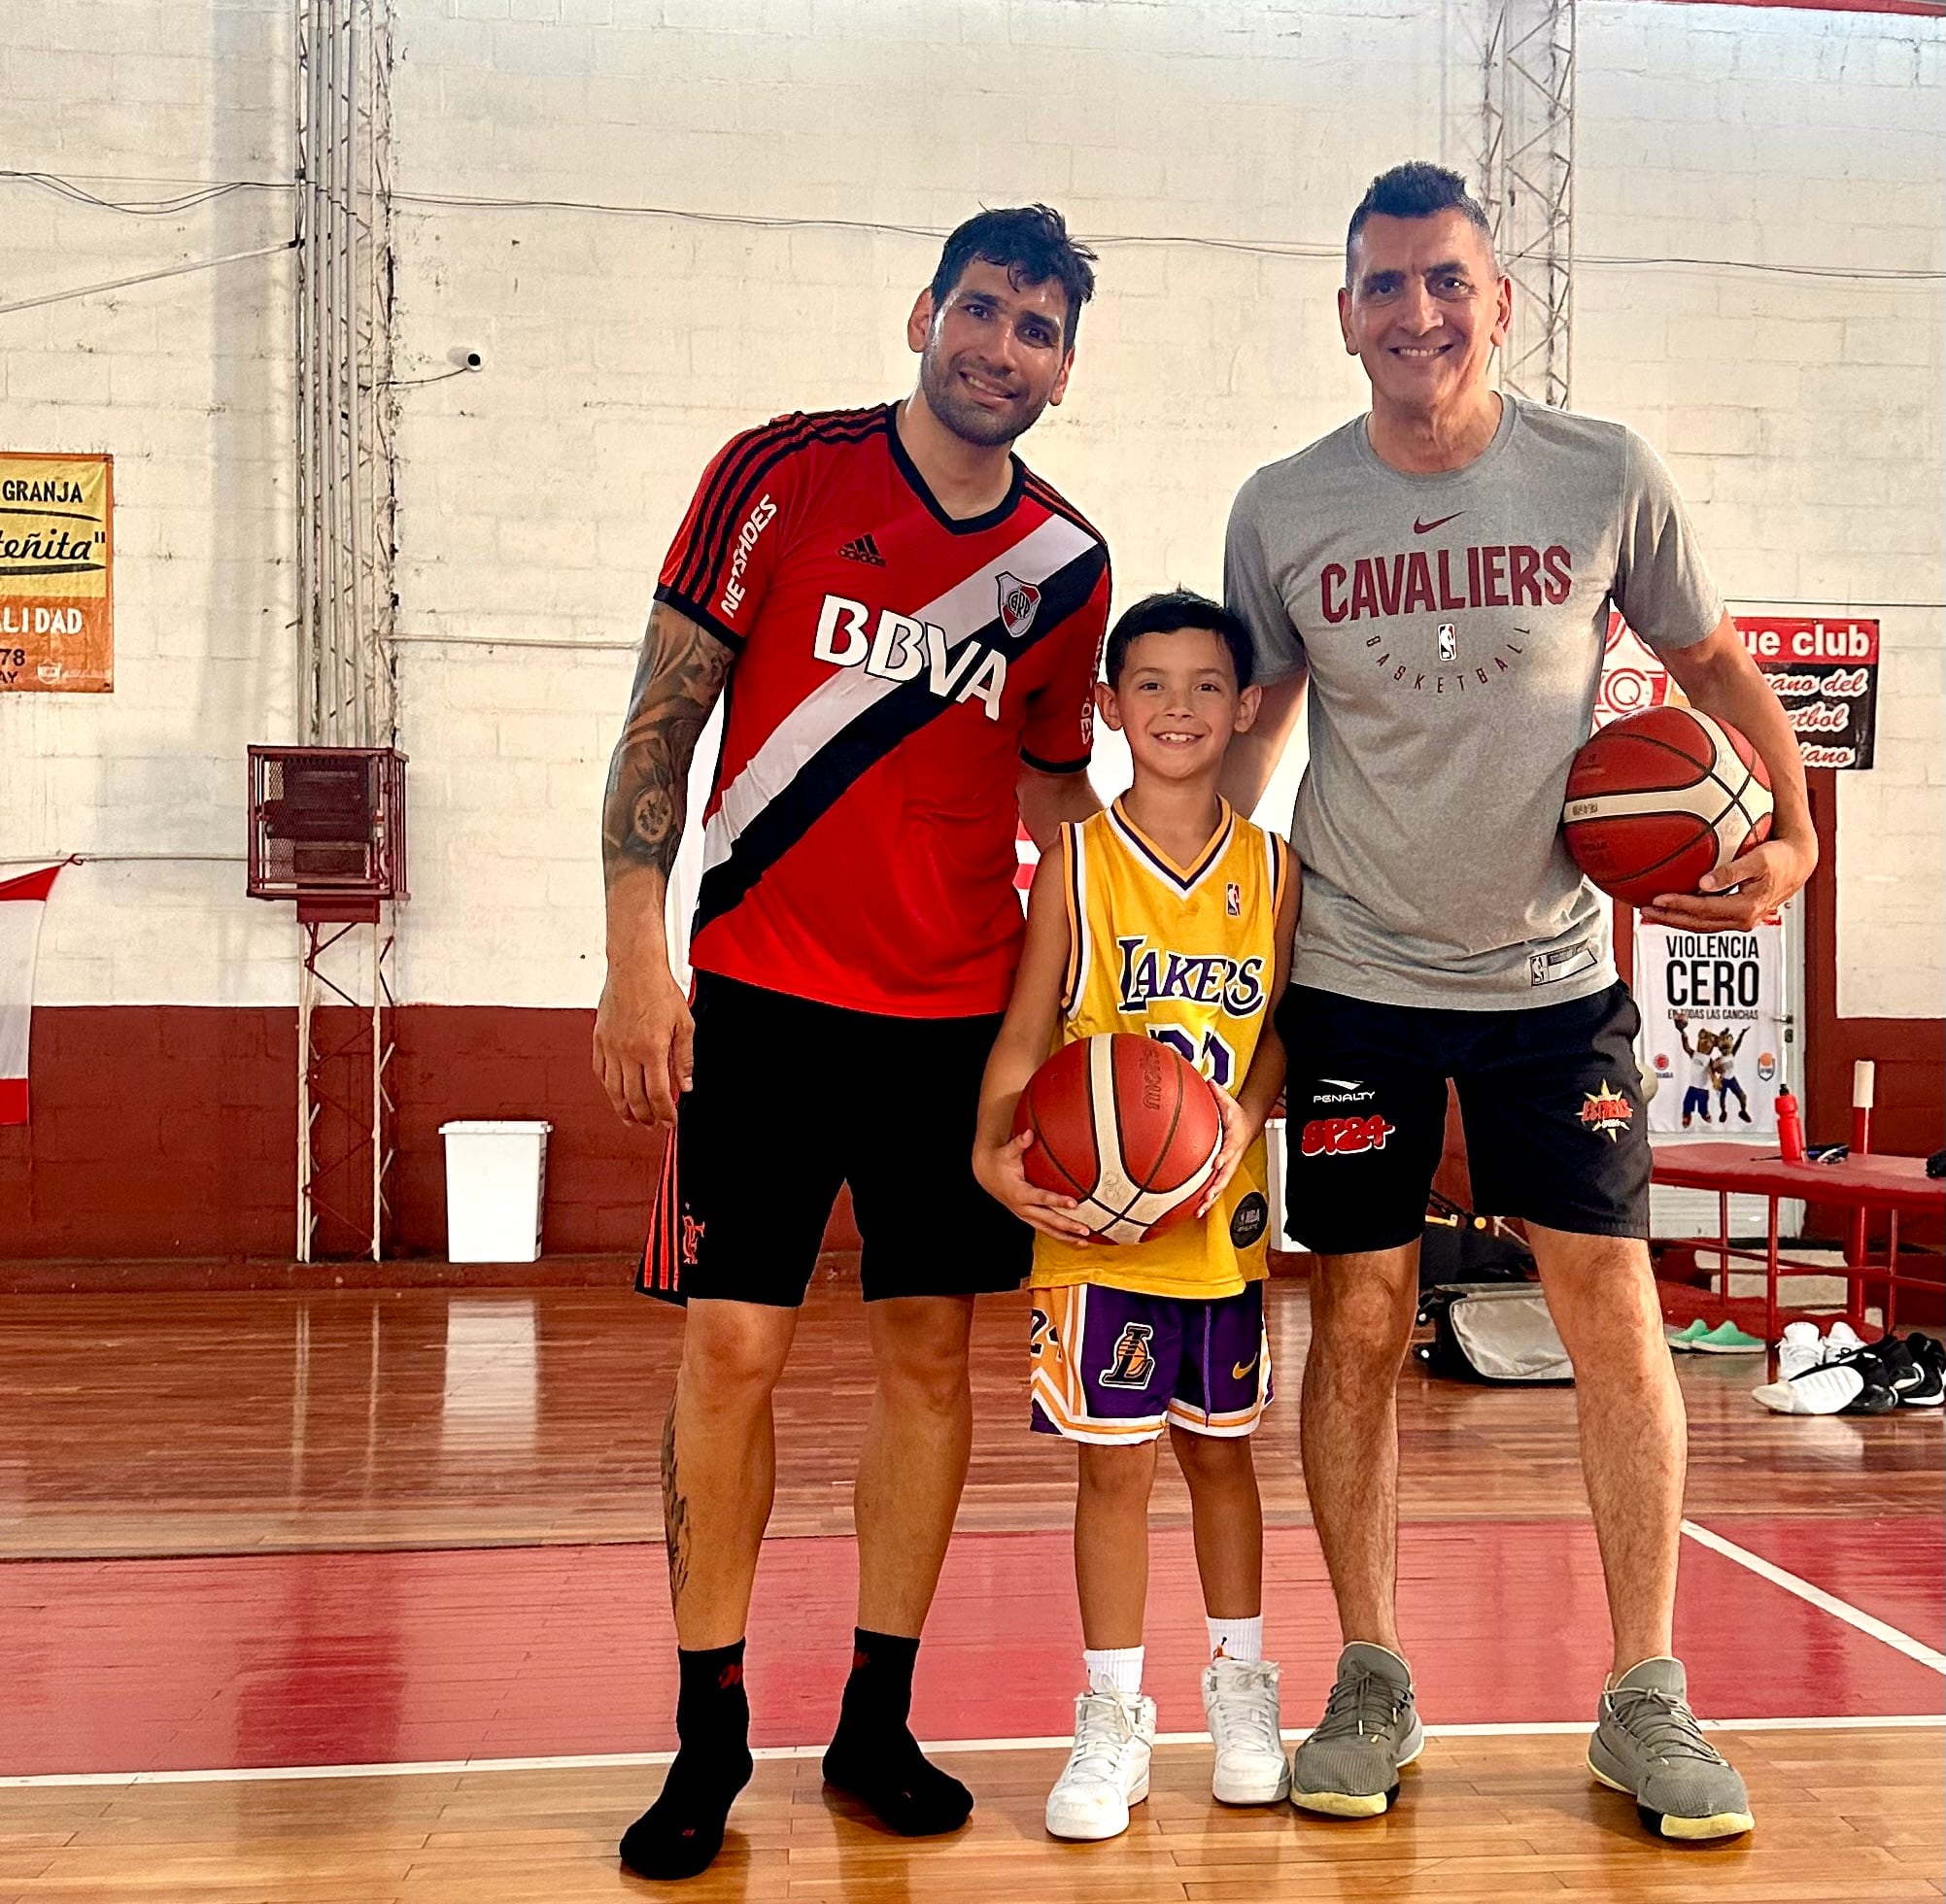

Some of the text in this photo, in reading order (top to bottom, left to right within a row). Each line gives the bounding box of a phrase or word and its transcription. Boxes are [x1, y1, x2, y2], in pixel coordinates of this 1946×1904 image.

[2, 480, 84, 503] GRANJA
[837, 548, 887, 567] adidas
[1320, 545, 1572, 624] CAVALIERS
[0, 606, 84, 635] LIDAD
[1792, 623, 1870, 657] club
[813, 595, 1007, 722] BBVA
[1366, 627, 1530, 694] BASKETBALL
[1823, 670, 1867, 696] del
[1665, 935, 1759, 959] VIOLENCIA
[1116, 935, 1267, 1019] LAKERS
[1666, 960, 1759, 1006] CERO
[1706, 1009, 1722, 1020] LAS
[1723, 1009, 1759, 1020] CANCHAS
[1313, 1091, 1376, 1104] PENALTY
